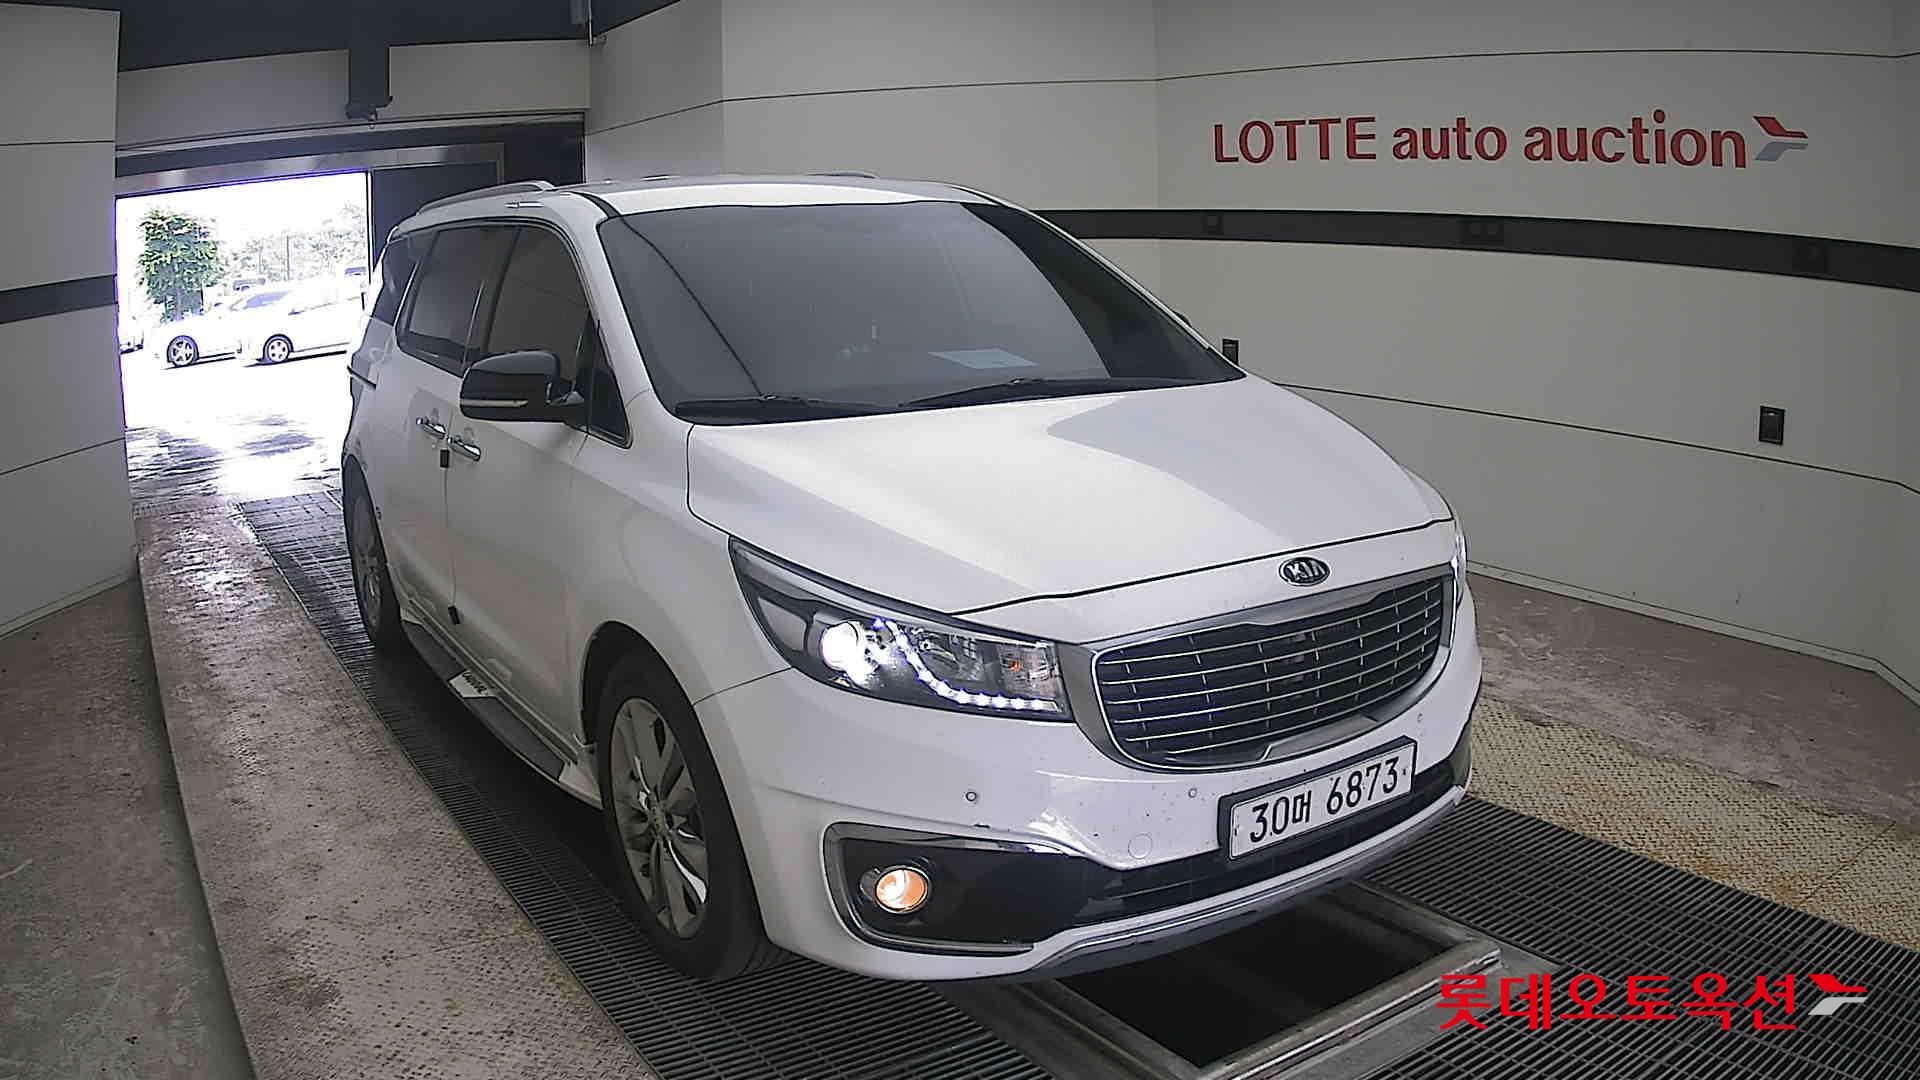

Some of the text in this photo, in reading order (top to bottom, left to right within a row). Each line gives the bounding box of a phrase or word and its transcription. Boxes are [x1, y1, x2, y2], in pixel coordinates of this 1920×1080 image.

[1213, 109, 1747, 169] LOTTE auto auction
[1285, 560, 1326, 581] KIA
[1250, 756, 1399, 843] 30머 6873
